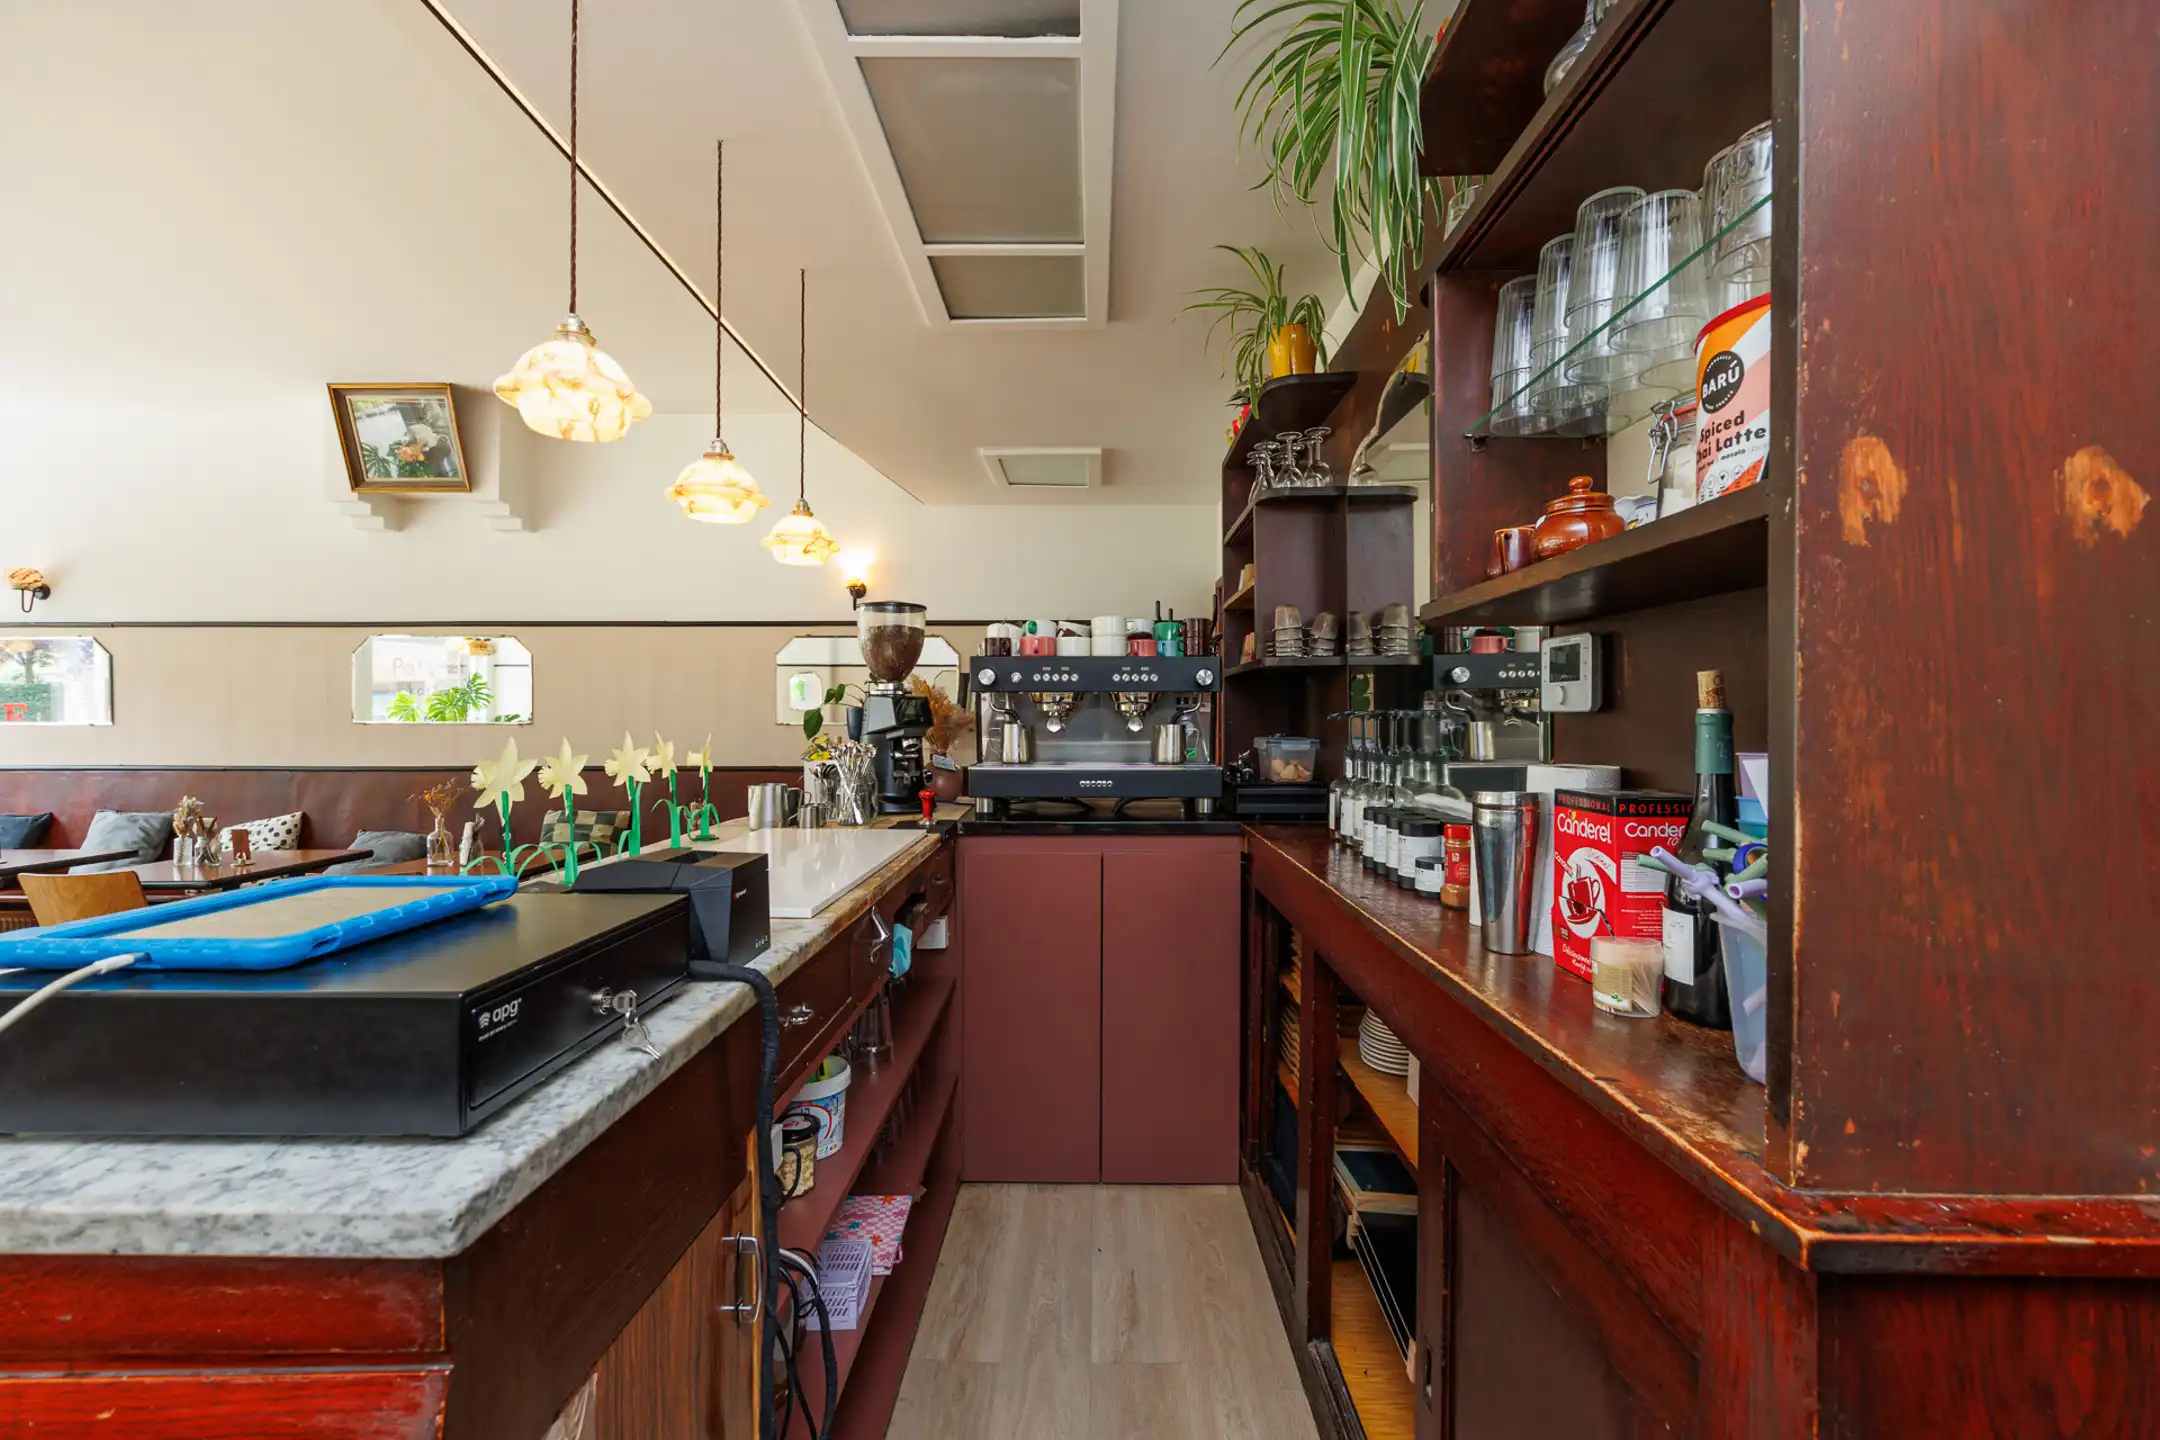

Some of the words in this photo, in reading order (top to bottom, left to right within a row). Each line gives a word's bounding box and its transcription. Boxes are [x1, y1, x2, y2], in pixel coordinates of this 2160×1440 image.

[1702, 359, 1740, 399] BARÚ
[1700, 410, 1745, 444] Spiced
[1718, 427, 1767, 452] Latte
[1557, 793, 1611, 813] PROFESSIONAL
[1557, 812, 1612, 844] Canderel
[492, 999, 519, 1023] apg
